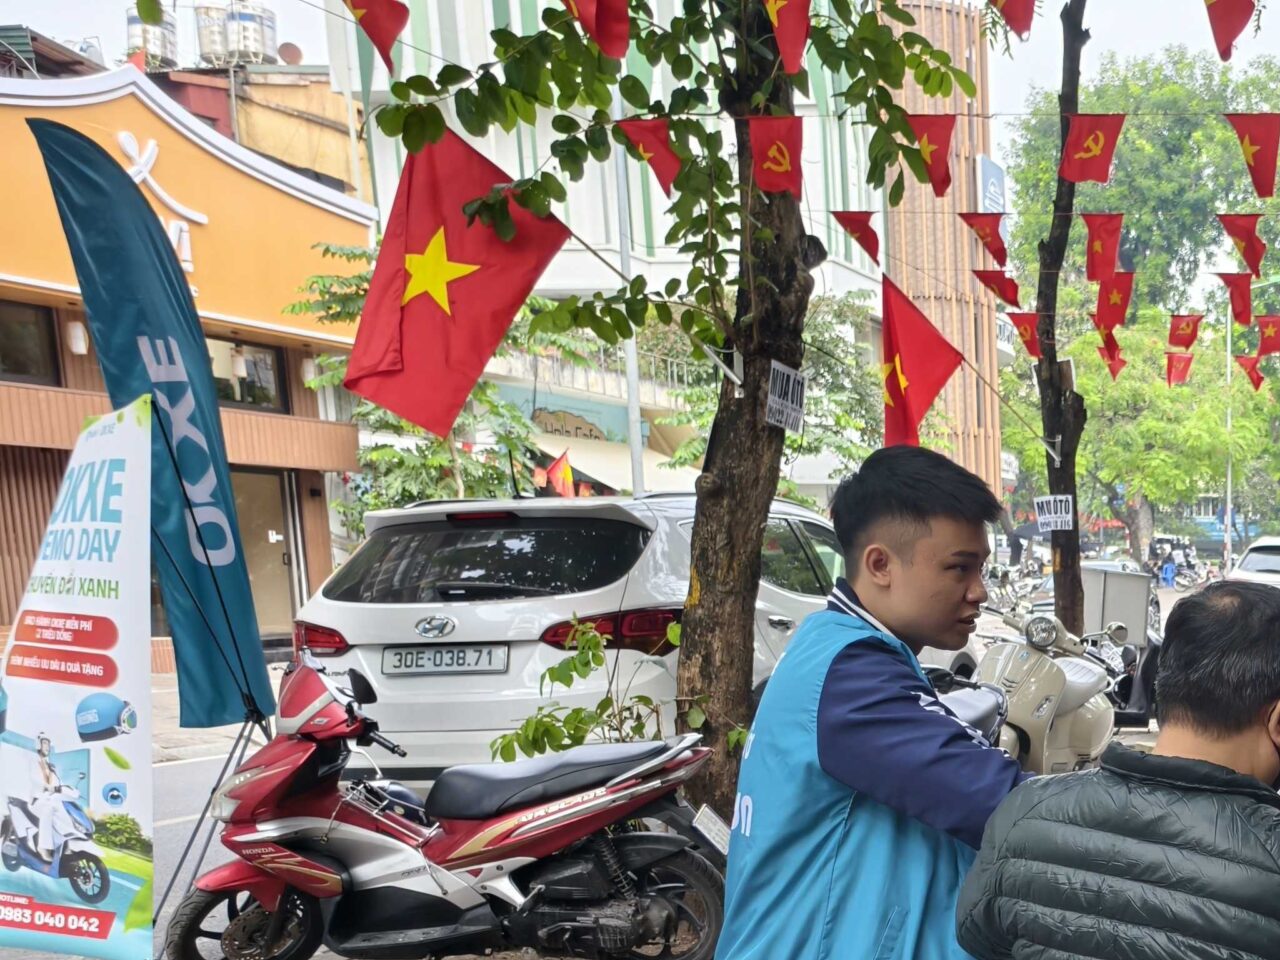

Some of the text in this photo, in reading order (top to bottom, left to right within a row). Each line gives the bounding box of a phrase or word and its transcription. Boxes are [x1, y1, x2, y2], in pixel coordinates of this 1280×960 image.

[42, 528, 121, 563] EMO DAY
[78, 575, 120, 600] XANH
[82, 663, 104, 677] TẶNG
[34, 911, 65, 928] 040
[68, 915, 99, 932] 042
